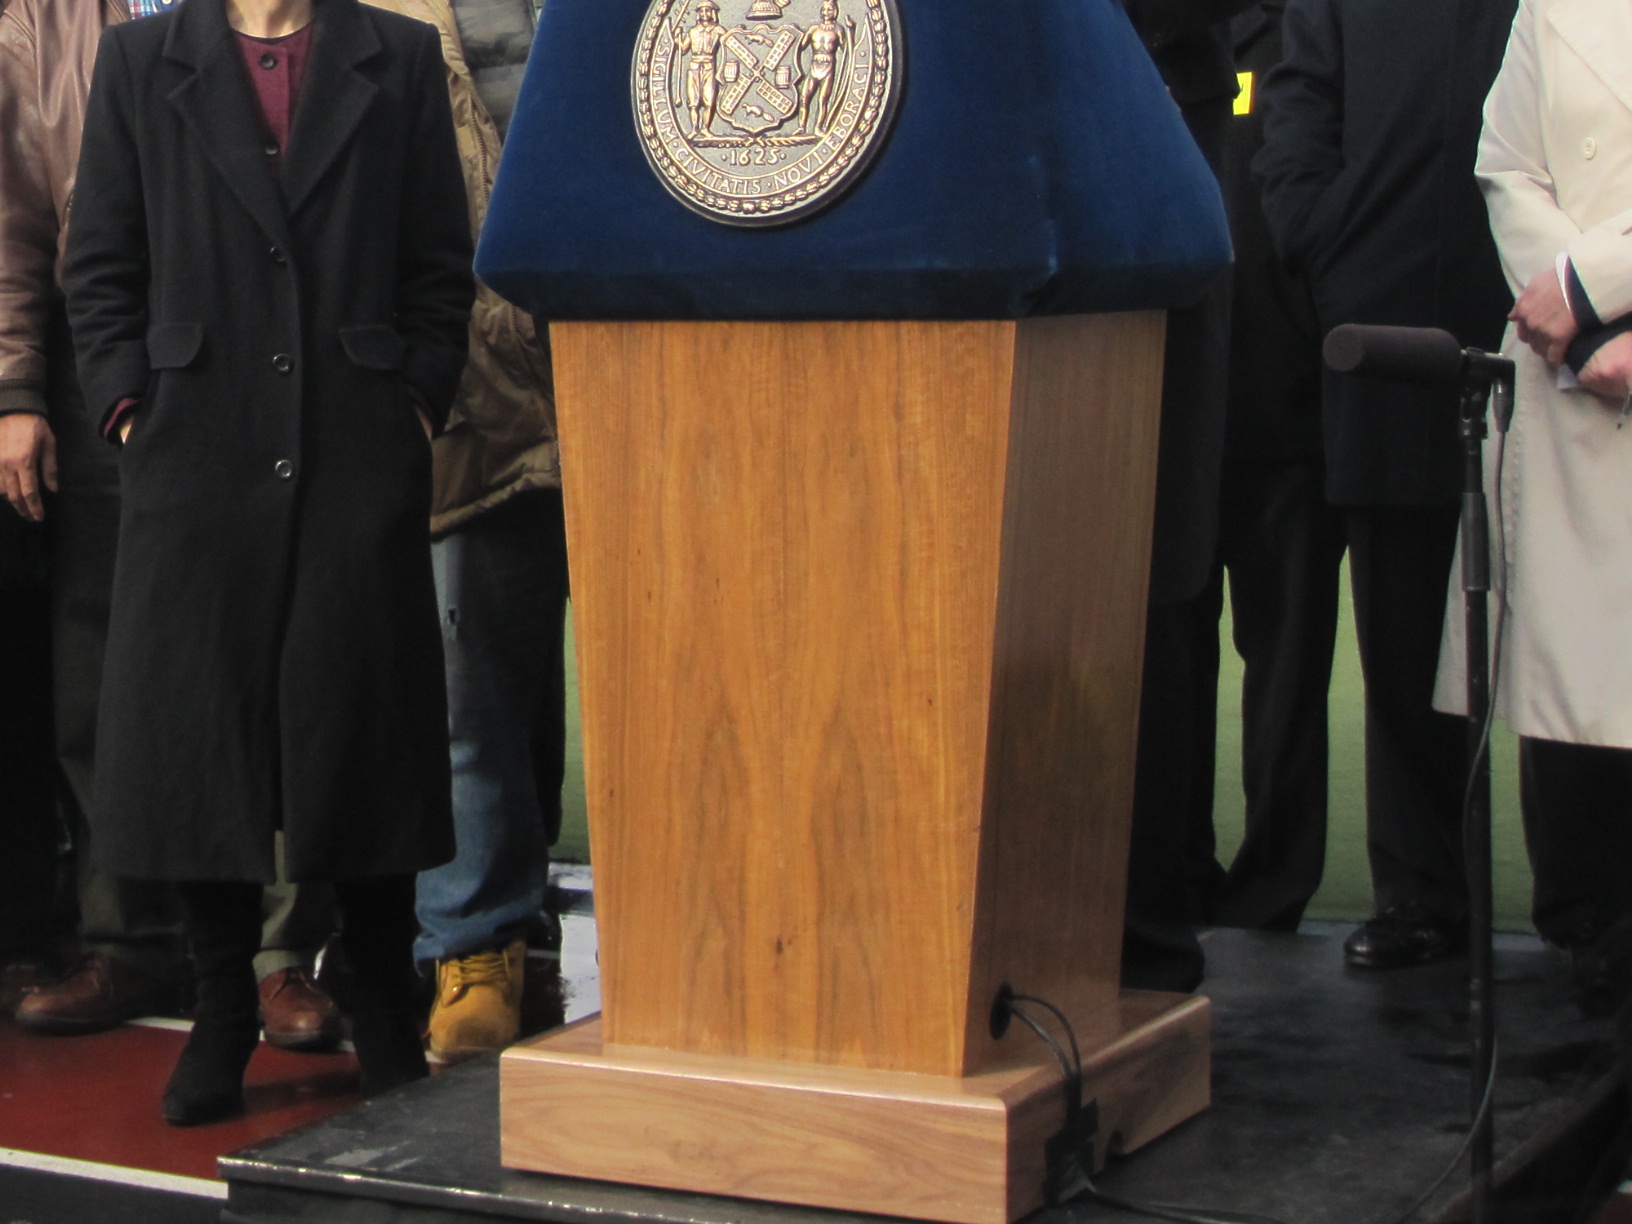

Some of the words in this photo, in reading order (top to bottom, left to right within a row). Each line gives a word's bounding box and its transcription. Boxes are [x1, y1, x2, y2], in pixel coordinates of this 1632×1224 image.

[651, 46, 678, 142] SIGILLUM
[675, 148, 762, 195] CIVITATIS
[774, 155, 823, 190] NOVI
[829, 63, 868, 153] EBORACI
[729, 148, 781, 167] 1625
